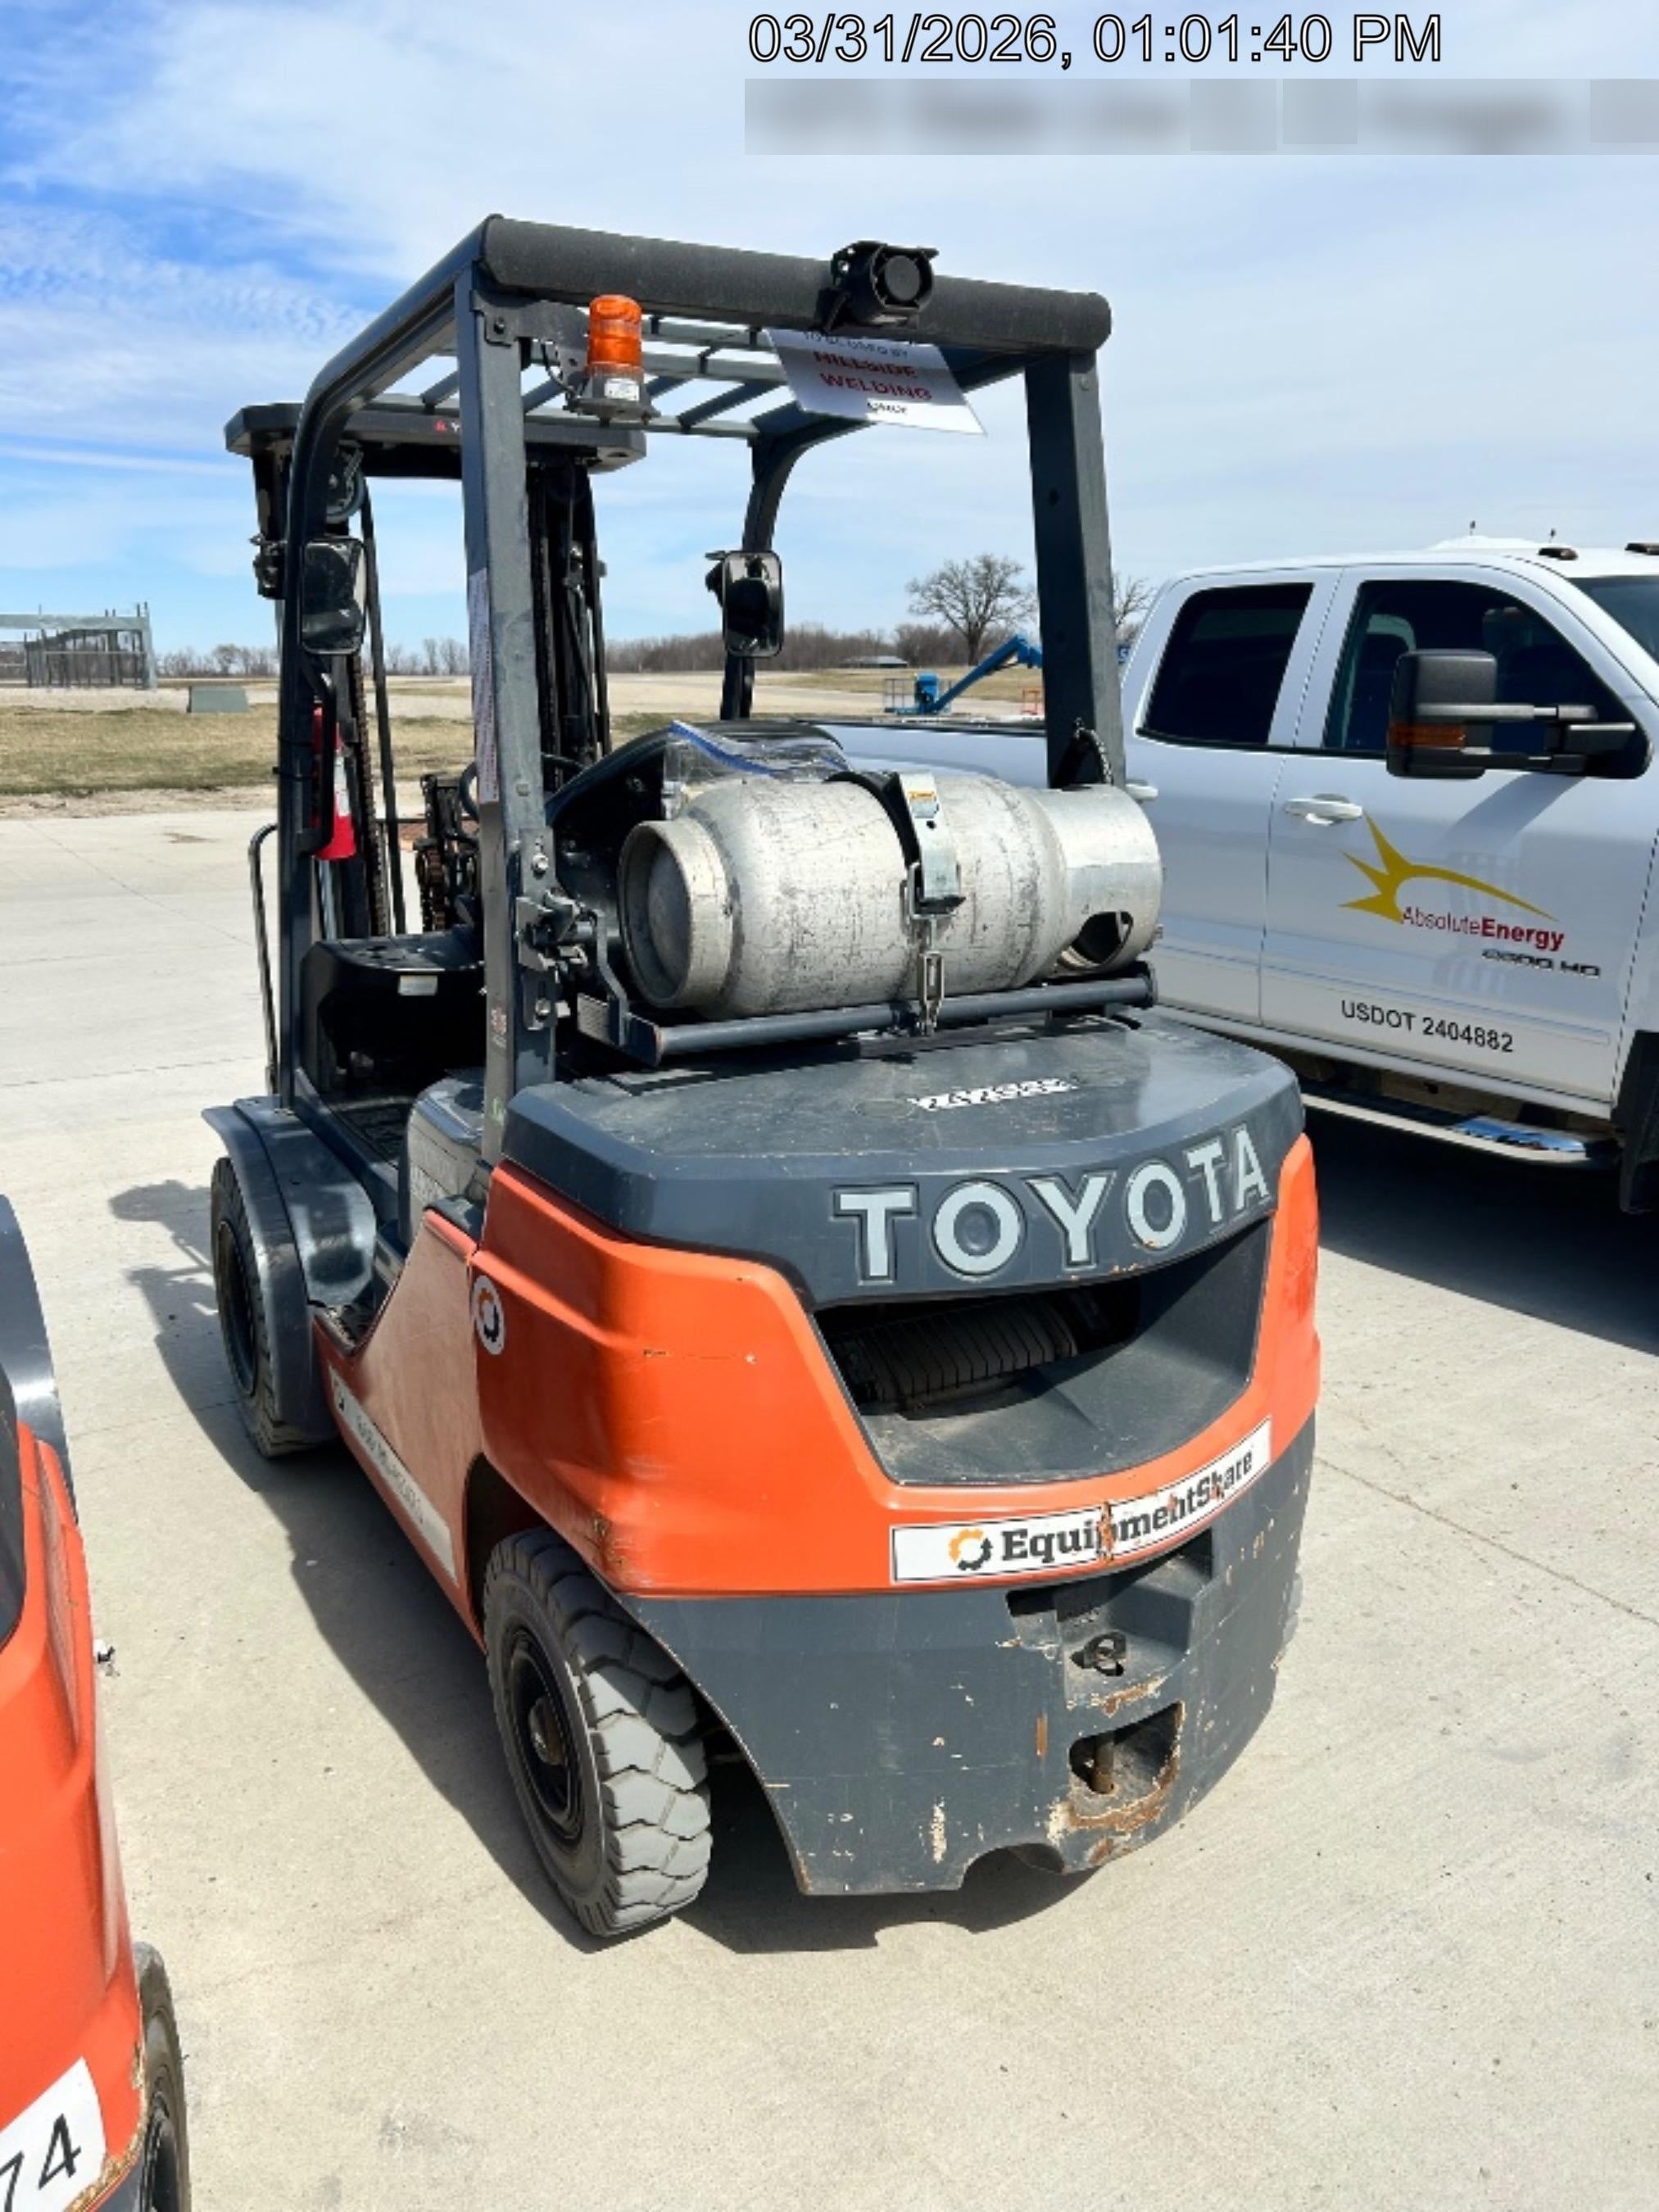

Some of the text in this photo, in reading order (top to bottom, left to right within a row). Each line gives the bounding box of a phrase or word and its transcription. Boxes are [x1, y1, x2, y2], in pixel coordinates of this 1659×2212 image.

[814, 351, 917, 378] HILLSIDE
[819, 373, 932, 401] WELDING
[1560, 960, 1601, 977] HD
[1341, 999, 1514, 1054] USDOT 2404882
[836, 1126, 1271, 1280] TOYOTA
